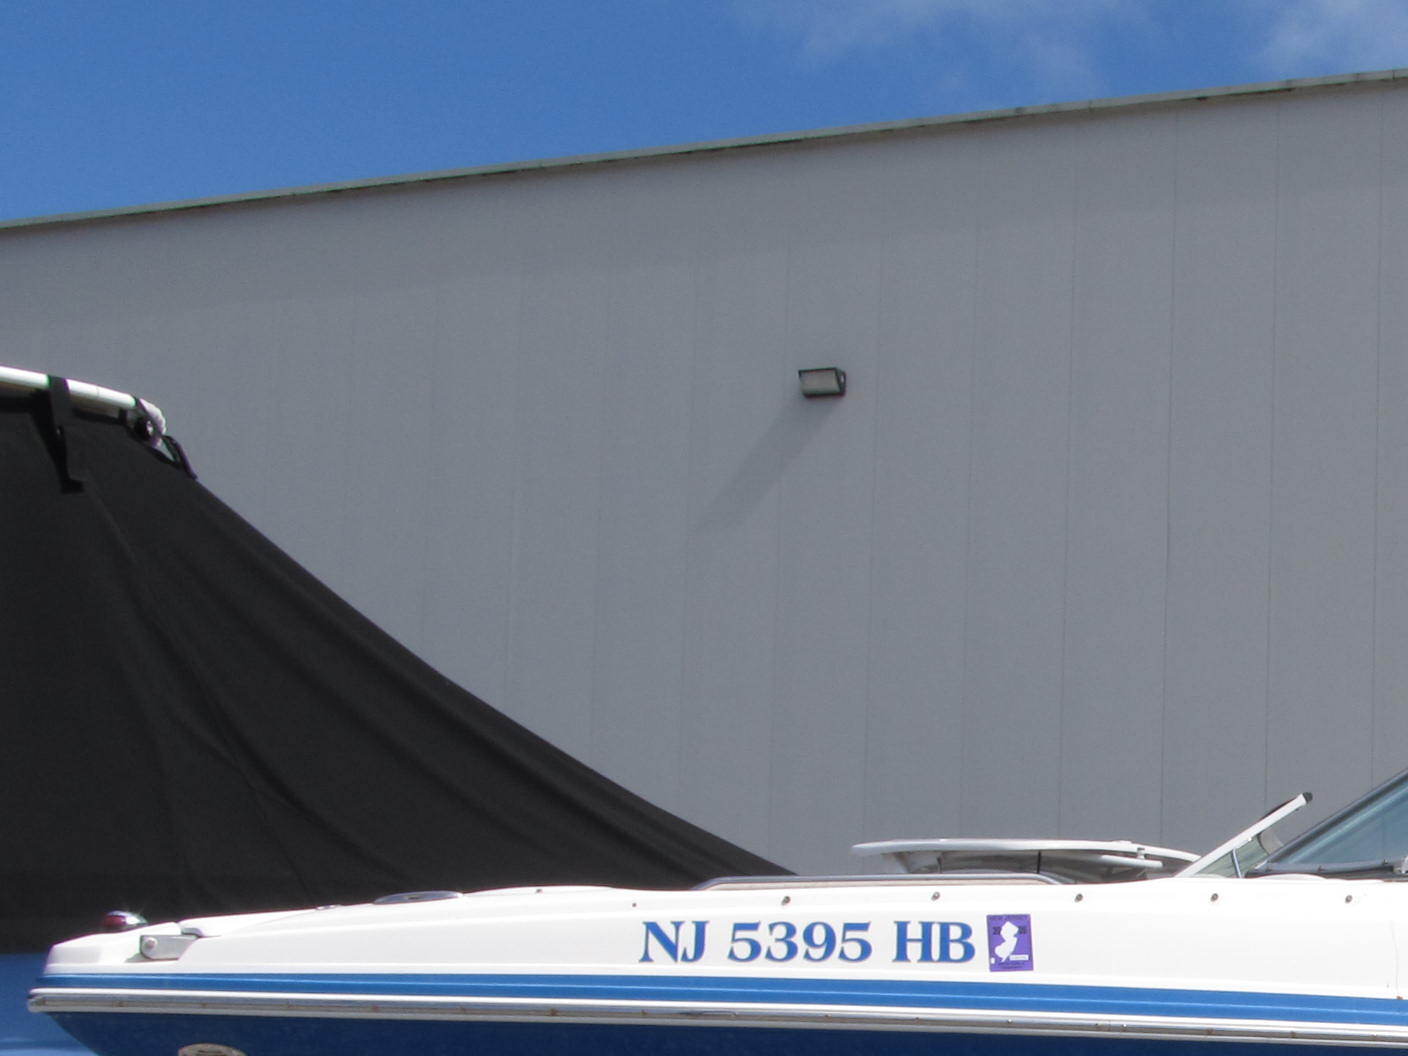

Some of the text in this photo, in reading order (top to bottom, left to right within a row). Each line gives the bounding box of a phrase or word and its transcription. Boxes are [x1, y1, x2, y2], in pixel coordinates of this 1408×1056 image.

[638, 920, 976, 963] NJ 5395 HB
